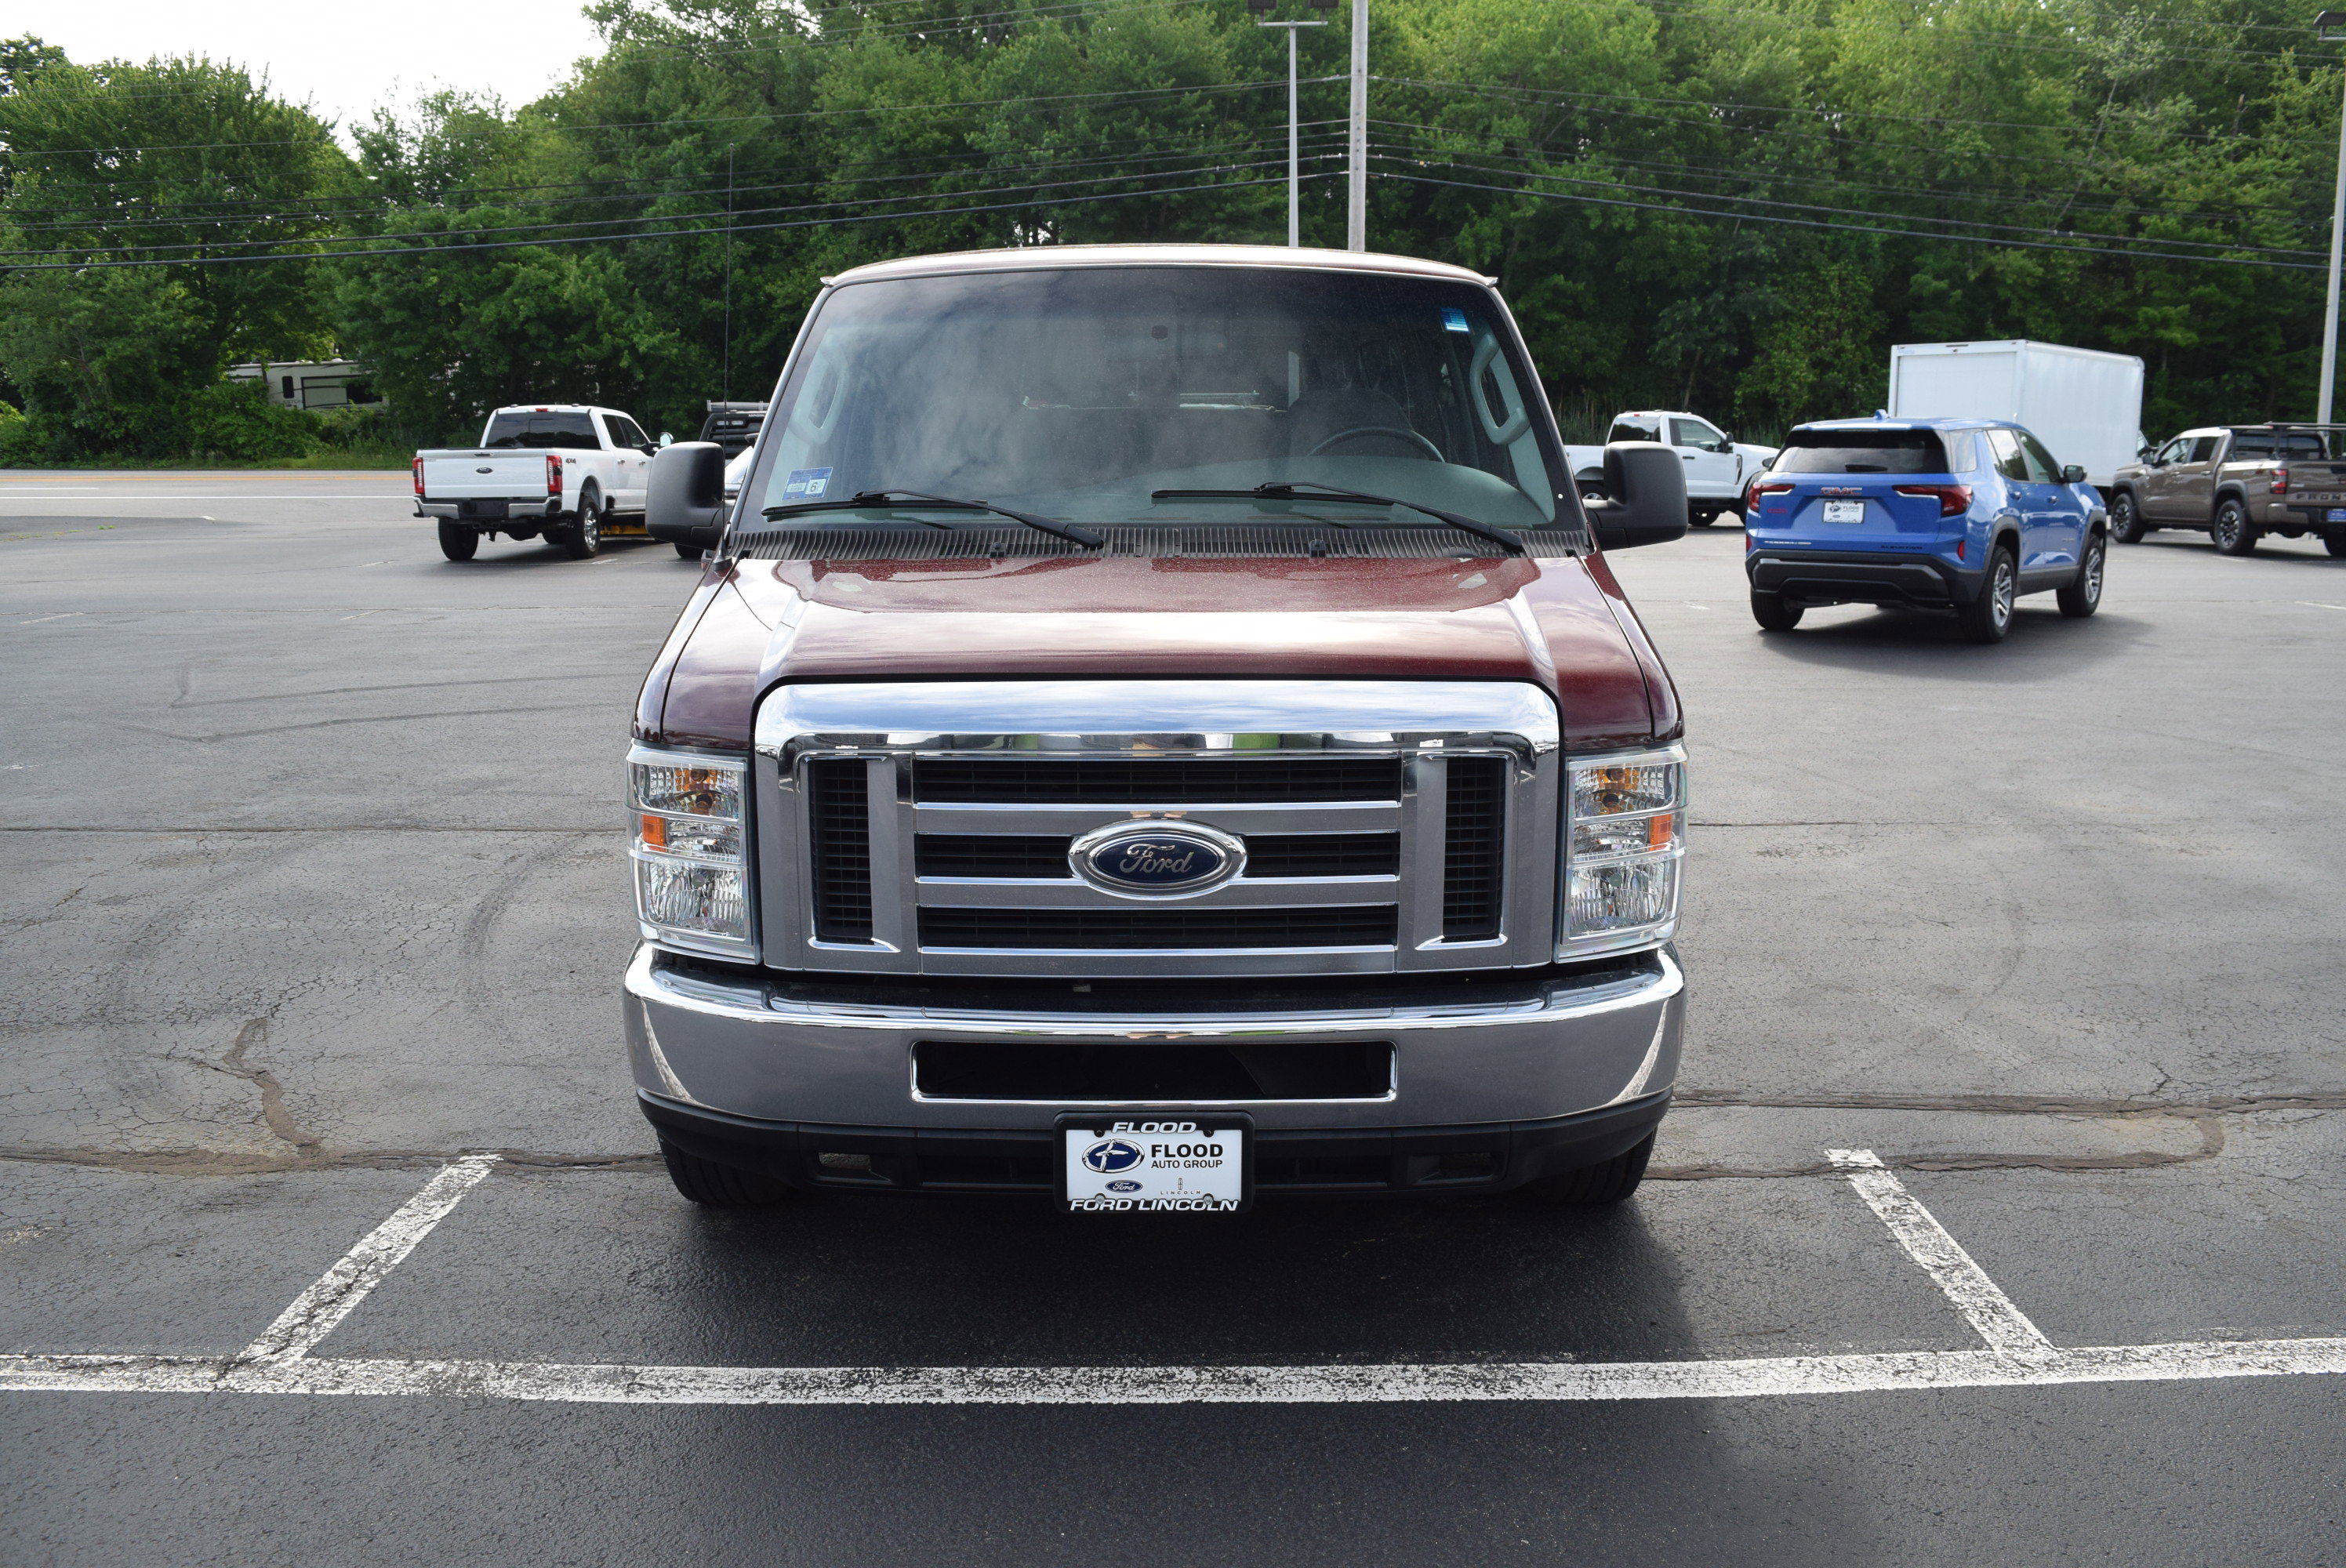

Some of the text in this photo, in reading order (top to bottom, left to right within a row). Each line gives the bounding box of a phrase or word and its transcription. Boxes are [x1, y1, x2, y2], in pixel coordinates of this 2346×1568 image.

[810, 482, 818, 492] 6
[1820, 486, 1863, 496] GMC
[1119, 843, 1194, 874] Ford
[1111, 1121, 1197, 1134] FLOOD
[1151, 1144, 1224, 1159] FLOOD
[1151, 1160, 1223, 1169] AUTO GROUP
[1112, 1181, 1136, 1192] Ford
[1070, 1198, 1239, 1212] FORD LINCOLN
